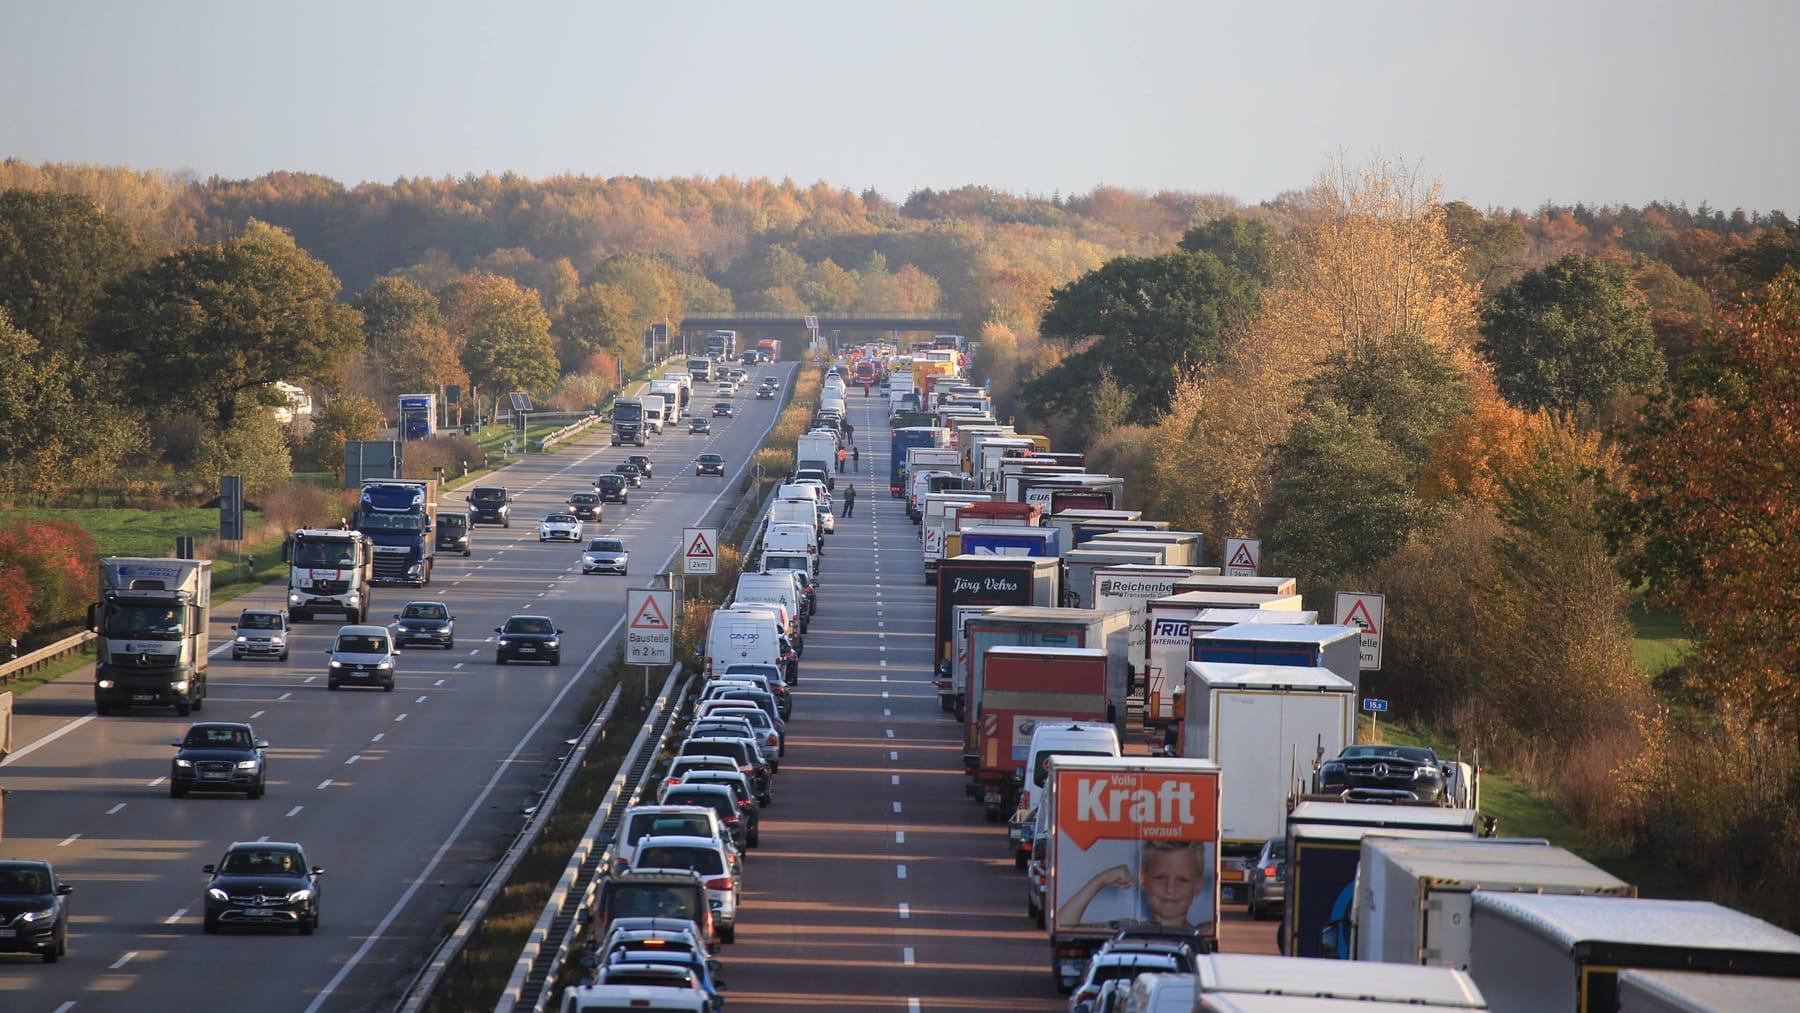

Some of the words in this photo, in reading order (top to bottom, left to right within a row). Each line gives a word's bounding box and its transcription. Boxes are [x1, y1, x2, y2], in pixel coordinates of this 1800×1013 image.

[953, 577, 981, 593] Jörg
[984, 577, 1017, 591] Vehrs
[1112, 581, 1172, 592] Reichenbe
[629, 633, 669, 643] Baustelle
[729, 633, 759, 643] cargo
[632, 647, 640, 656] in
[643, 647, 649, 656] 2
[651, 647, 665, 656] km
[1360, 653, 1373, 661] km
[1111, 775, 1137, 786] Volle
[1077, 778, 1195, 824] Kraft
[1143, 825, 1182, 837] voraus!
